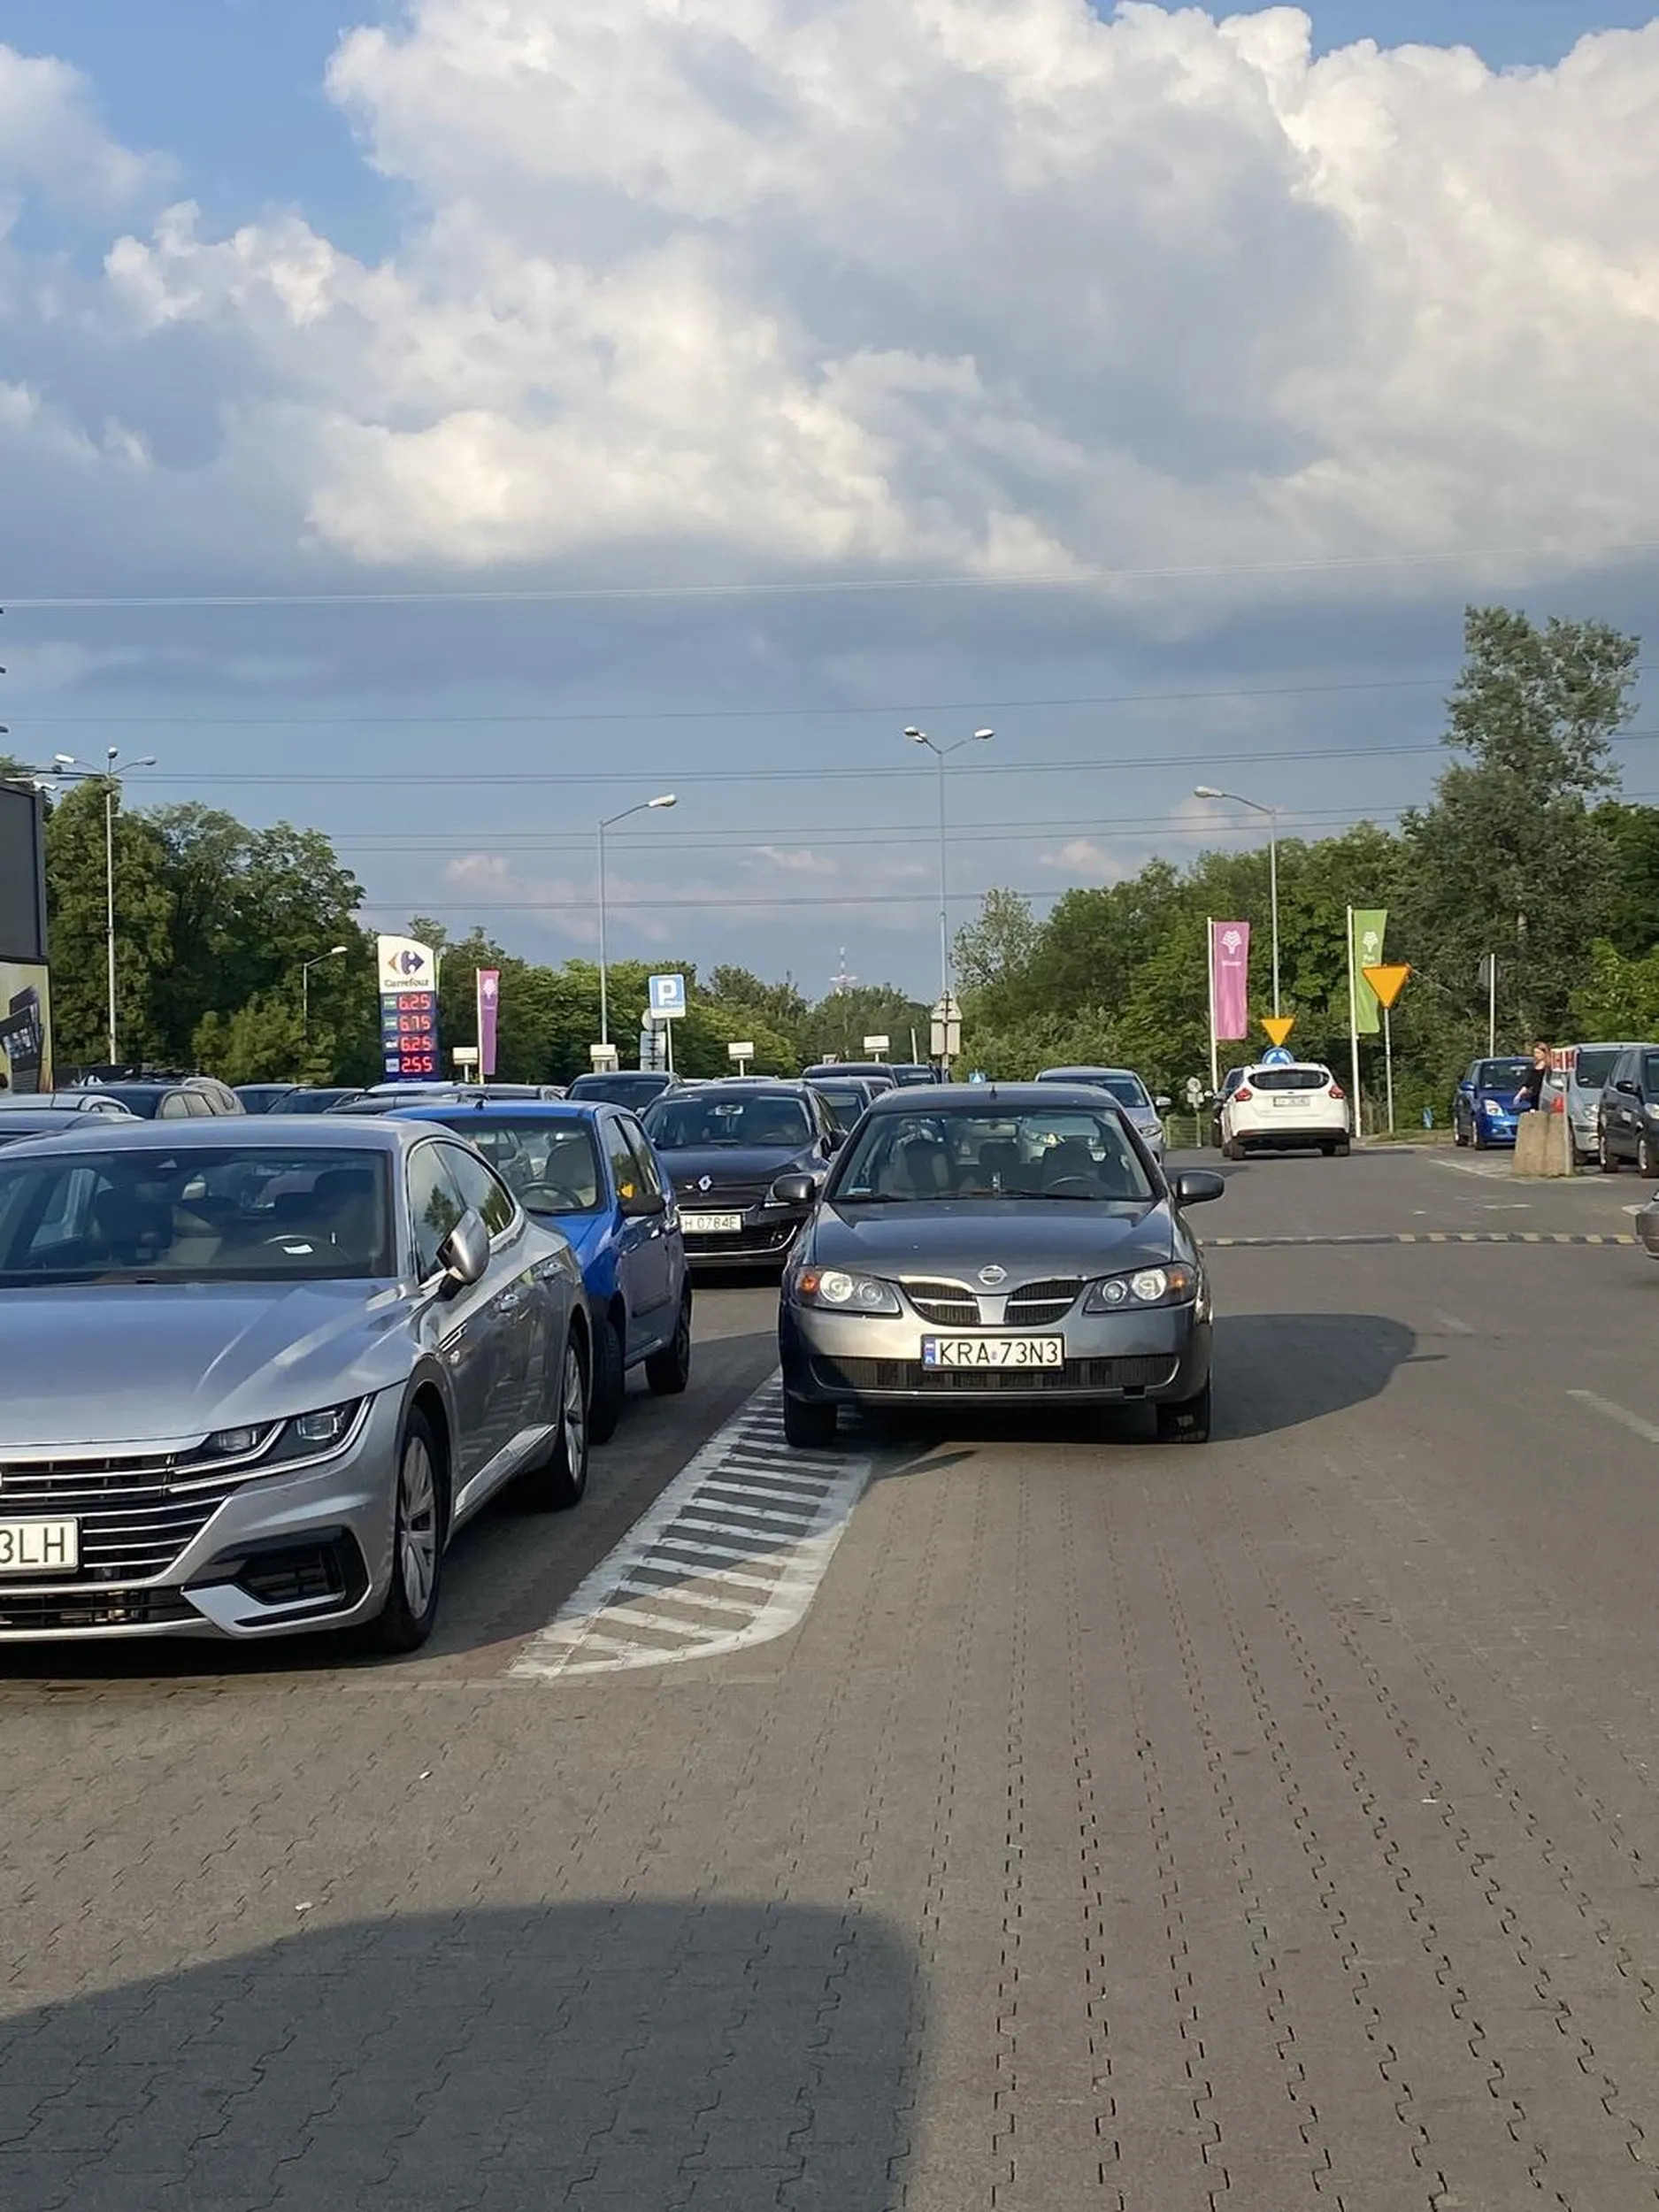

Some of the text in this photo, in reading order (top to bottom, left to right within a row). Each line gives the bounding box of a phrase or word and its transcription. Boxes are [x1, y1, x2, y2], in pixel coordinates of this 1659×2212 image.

[384, 978, 429, 987] Carrefour
[657, 979, 678, 1007] P
[940, 1340, 1058, 1364] KRA 73N3
[0, 1526, 65, 1564] 3LH
